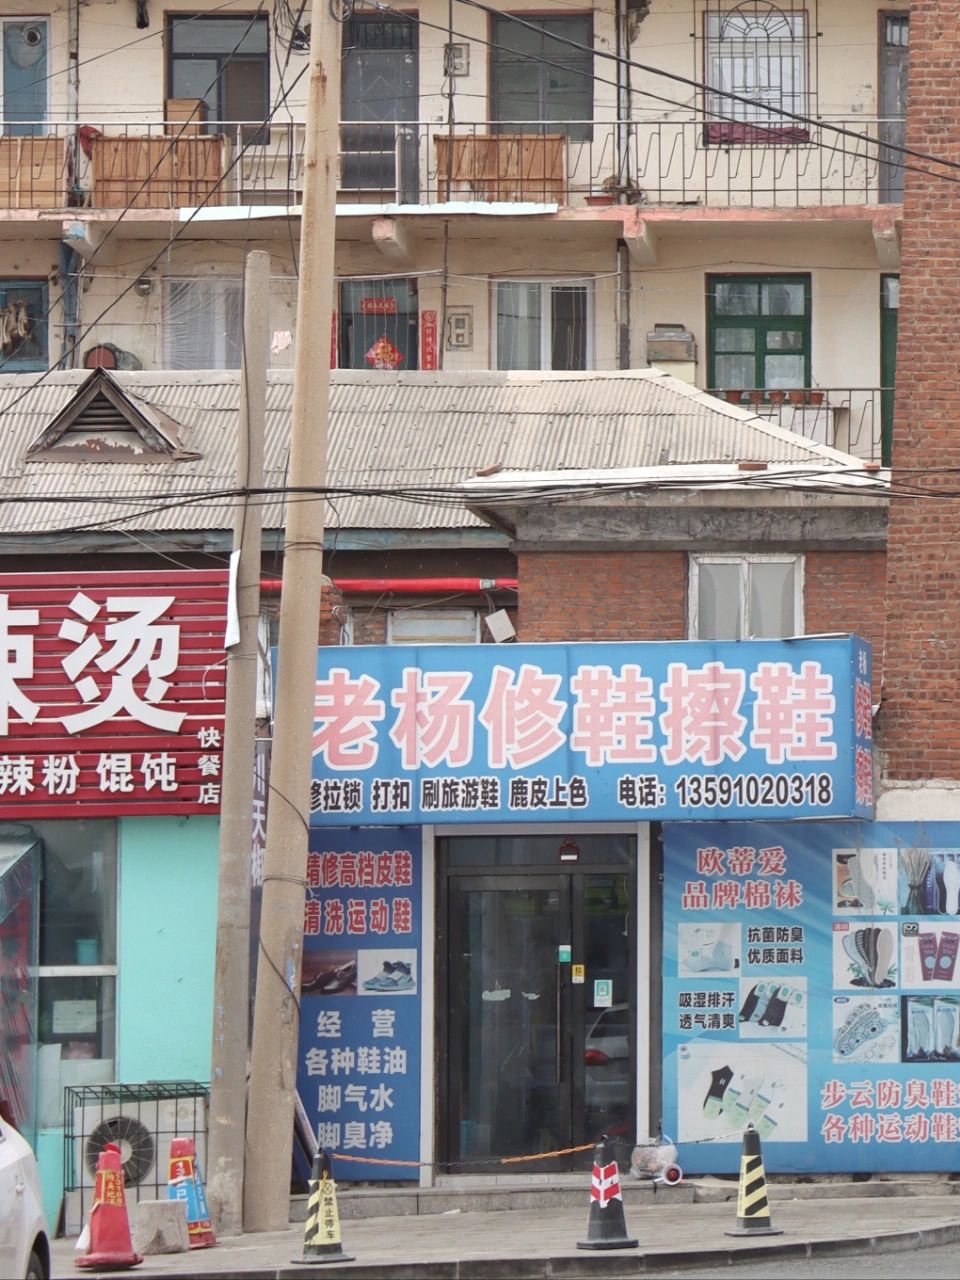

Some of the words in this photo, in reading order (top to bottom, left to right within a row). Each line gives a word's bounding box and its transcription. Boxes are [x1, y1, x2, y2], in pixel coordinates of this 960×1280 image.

[309, 662, 837, 771] 老杨修鞋擦鞋
[0, 753, 80, 796] 辣粉
[96, 751, 179, 793] 馄饨
[197, 726, 221, 804] 快餐店
[371, 777, 412, 812] 打扣
[420, 775, 501, 810] 刷旅游鞋
[508, 774, 590, 809] 鹿皮上色
[674, 772, 834, 809] 13591020318
[696, 845, 787, 876] 欧蒂爱
[682, 879, 803, 910] 品牌棉袜
[304, 898, 413, 935] 清洗运动鞋
[747, 926, 804, 944] 抗菌防臭
[747, 947, 804, 965] 优质面料
[679, 991, 736, 1009] 吸湿排汗
[678, 1012, 736, 1030] 透气清爽
[305, 1045, 408, 1077] 各种鞋油
[317, 1082, 395, 1113] 脚气水
[317, 1120, 394, 1150] 脚臭净
[323, 1197, 336, 1239] 禁止停车
